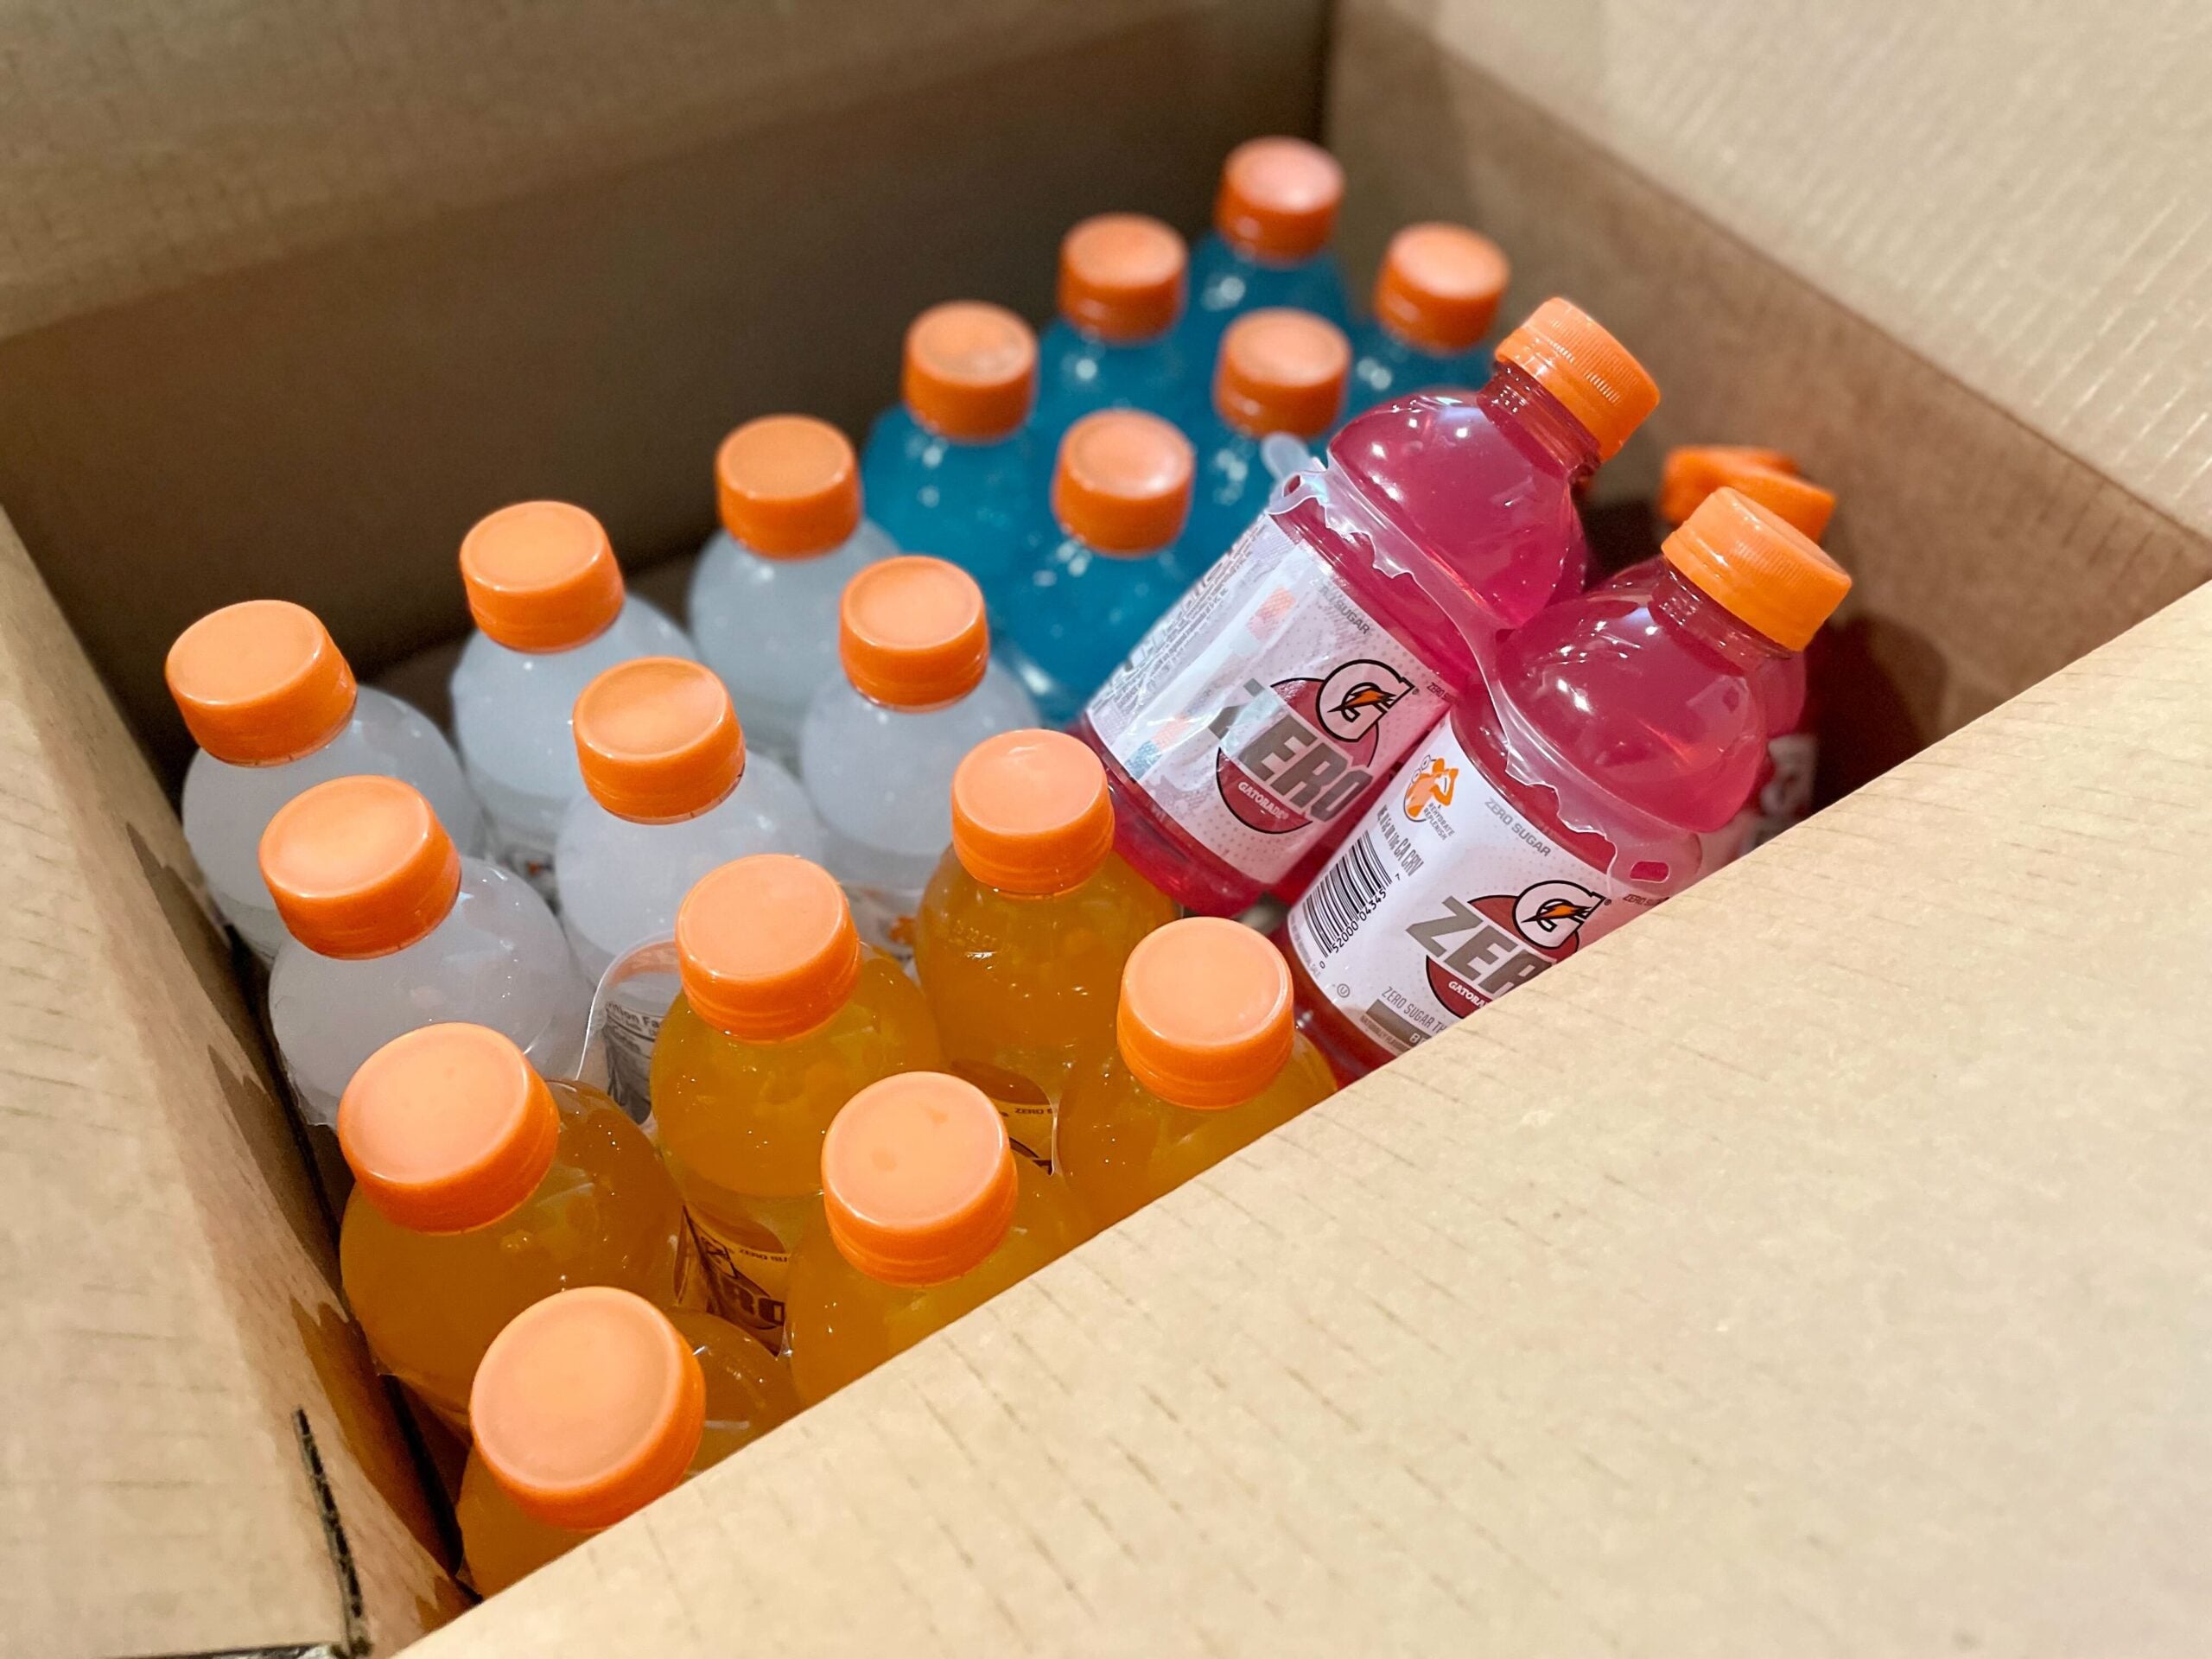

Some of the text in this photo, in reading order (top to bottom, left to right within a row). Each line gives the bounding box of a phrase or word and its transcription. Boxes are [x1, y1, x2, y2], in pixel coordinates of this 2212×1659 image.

[1424, 809, 1447, 841] REPLENISH
[1428, 803, 1455, 836] REHYDRATE
[1484, 798, 1551, 856] ZERO SUGAR
[1394, 838, 1409, 861] CA
[1401, 847, 1424, 877] CRV
[1332, 920, 1358, 953] 52000
[1359, 888, 1386, 921] 04345
[1406, 895, 1553, 995] ZER
[1382, 986, 1406, 1009] ZERO
[1404, 1003, 1433, 1030] SUGAR
[1448, 981, 1489, 1008] GATORA
